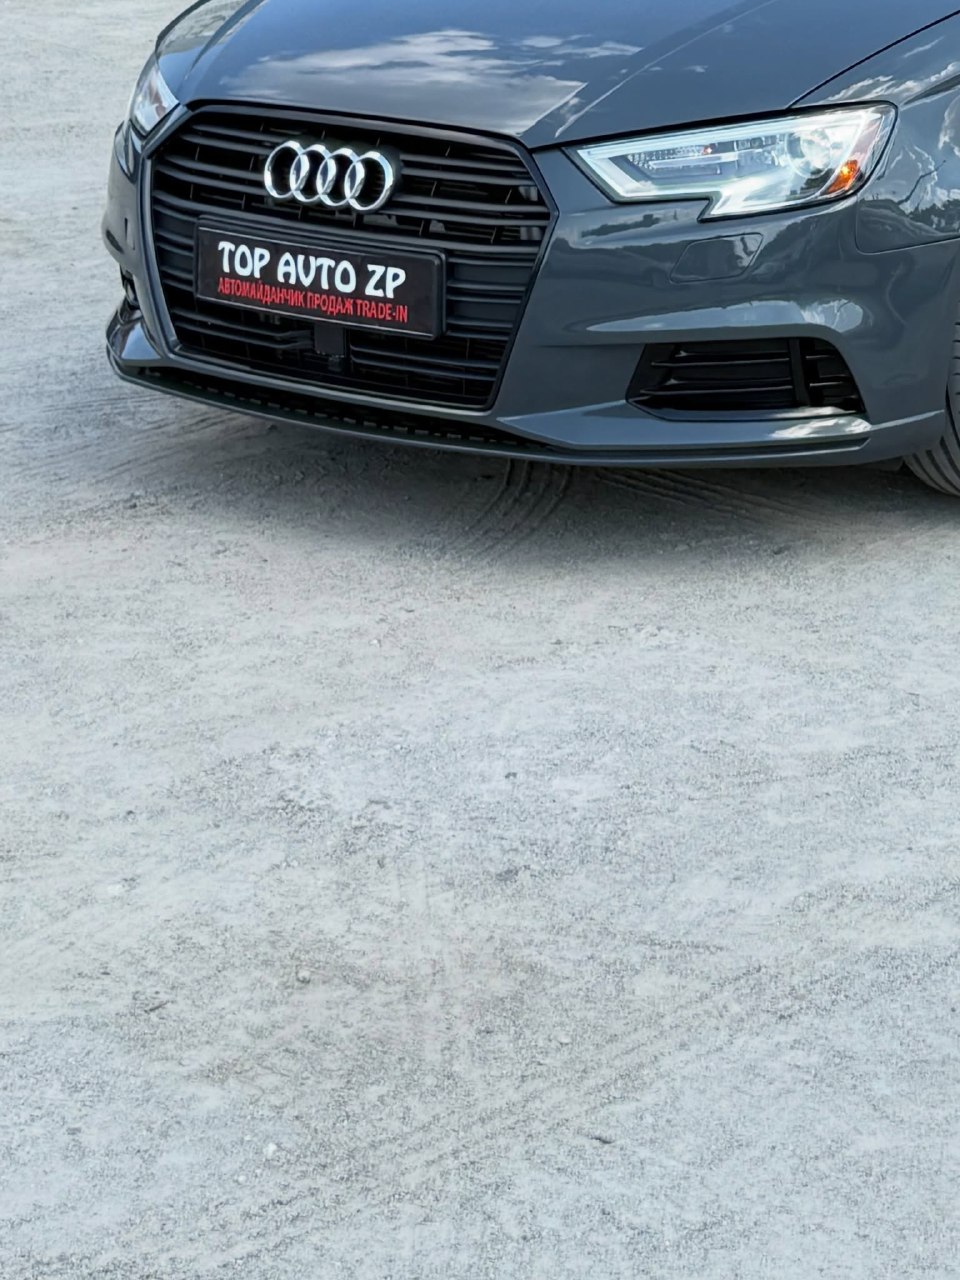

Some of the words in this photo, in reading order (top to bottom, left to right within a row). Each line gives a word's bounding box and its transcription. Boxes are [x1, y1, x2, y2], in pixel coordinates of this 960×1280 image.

[217, 240, 271, 279] TOP
[364, 263, 406, 299] ZP
[217, 276, 305, 308] АВТОМАЙДАНЧИК
[306, 291, 354, 317] ПРОДАЖ
[354, 299, 408, 323] TRADE-IN
